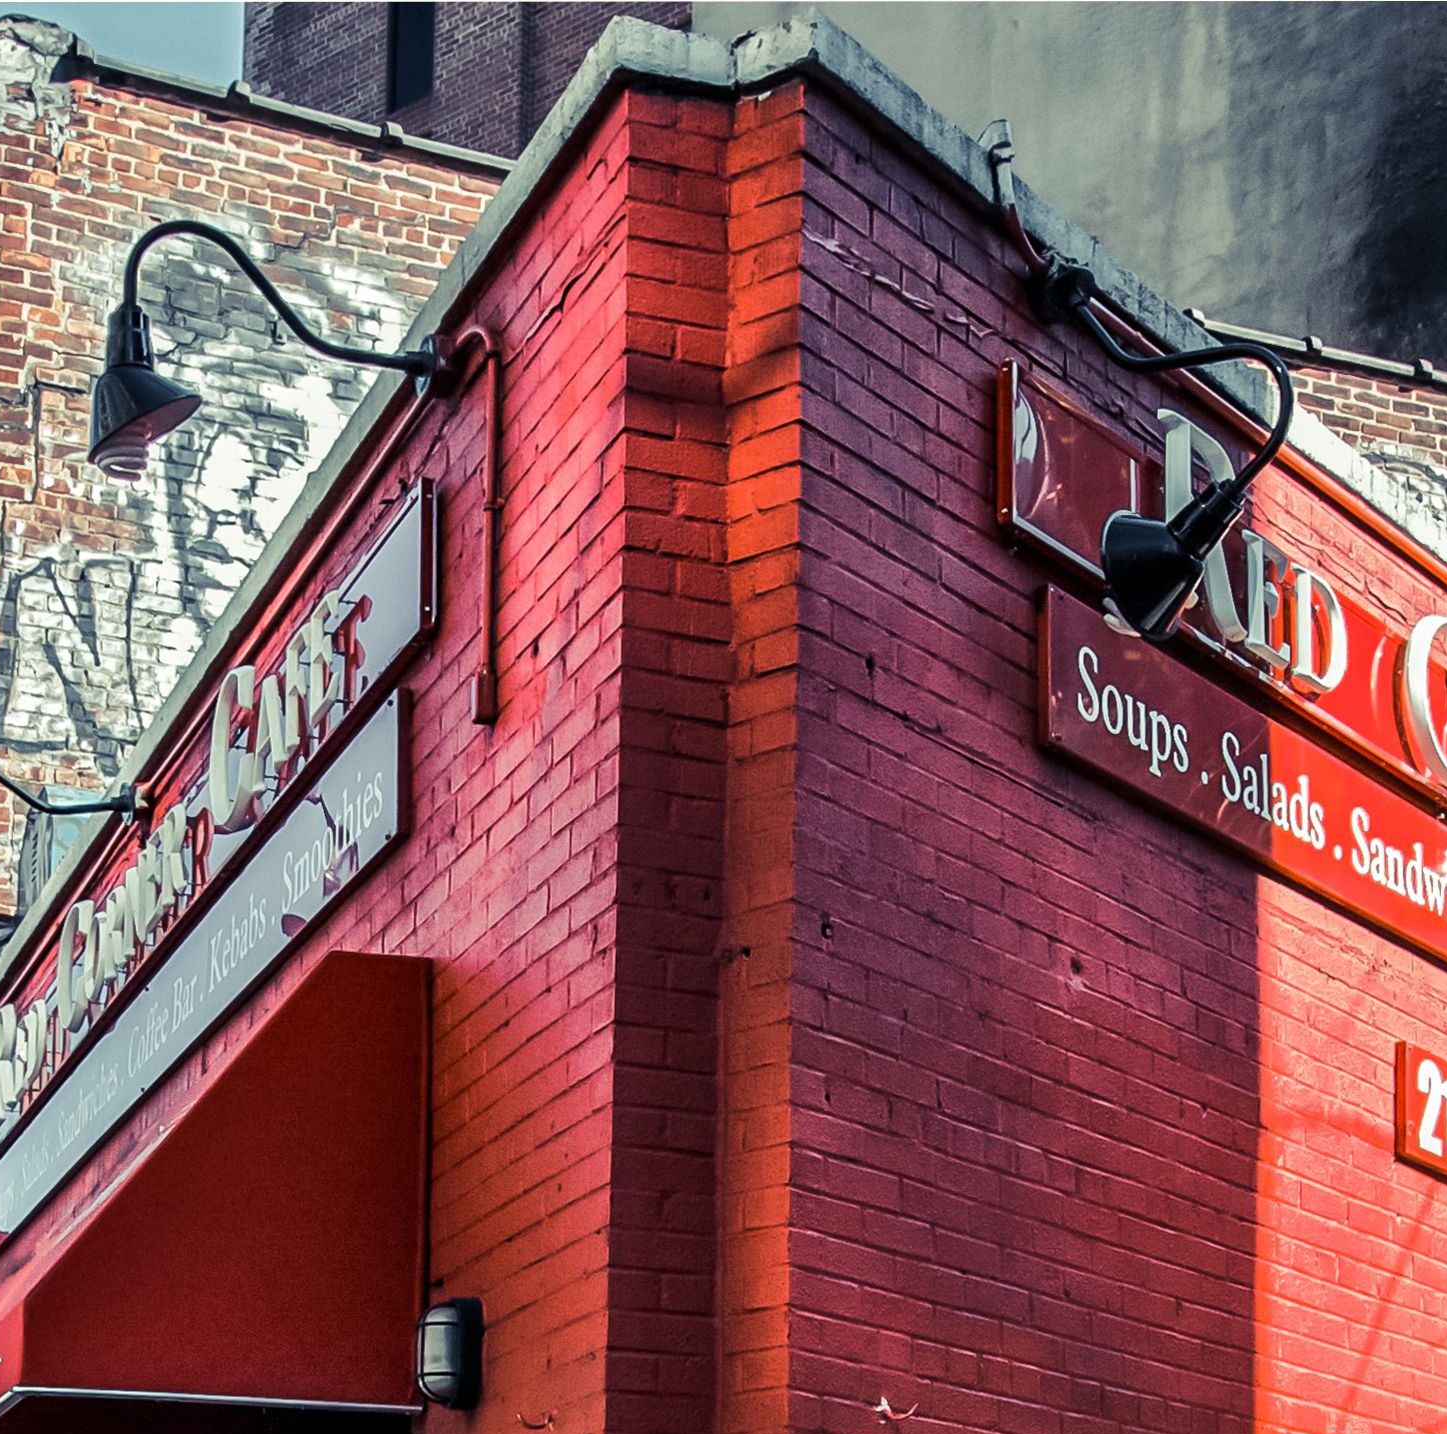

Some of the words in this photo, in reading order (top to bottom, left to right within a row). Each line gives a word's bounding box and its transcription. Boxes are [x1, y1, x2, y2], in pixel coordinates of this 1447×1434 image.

[1076, 646, 1190, 777] Soups
[1221, 731, 1326, 851] Salads
[57, 803, 188, 1033] CORNER
[127, 1001, 169, 1079] Coffee
[171, 974, 198, 1033] Bar
[209, 893, 267, 993] Kebabs
[281, 771, 383, 914] Smoothies
